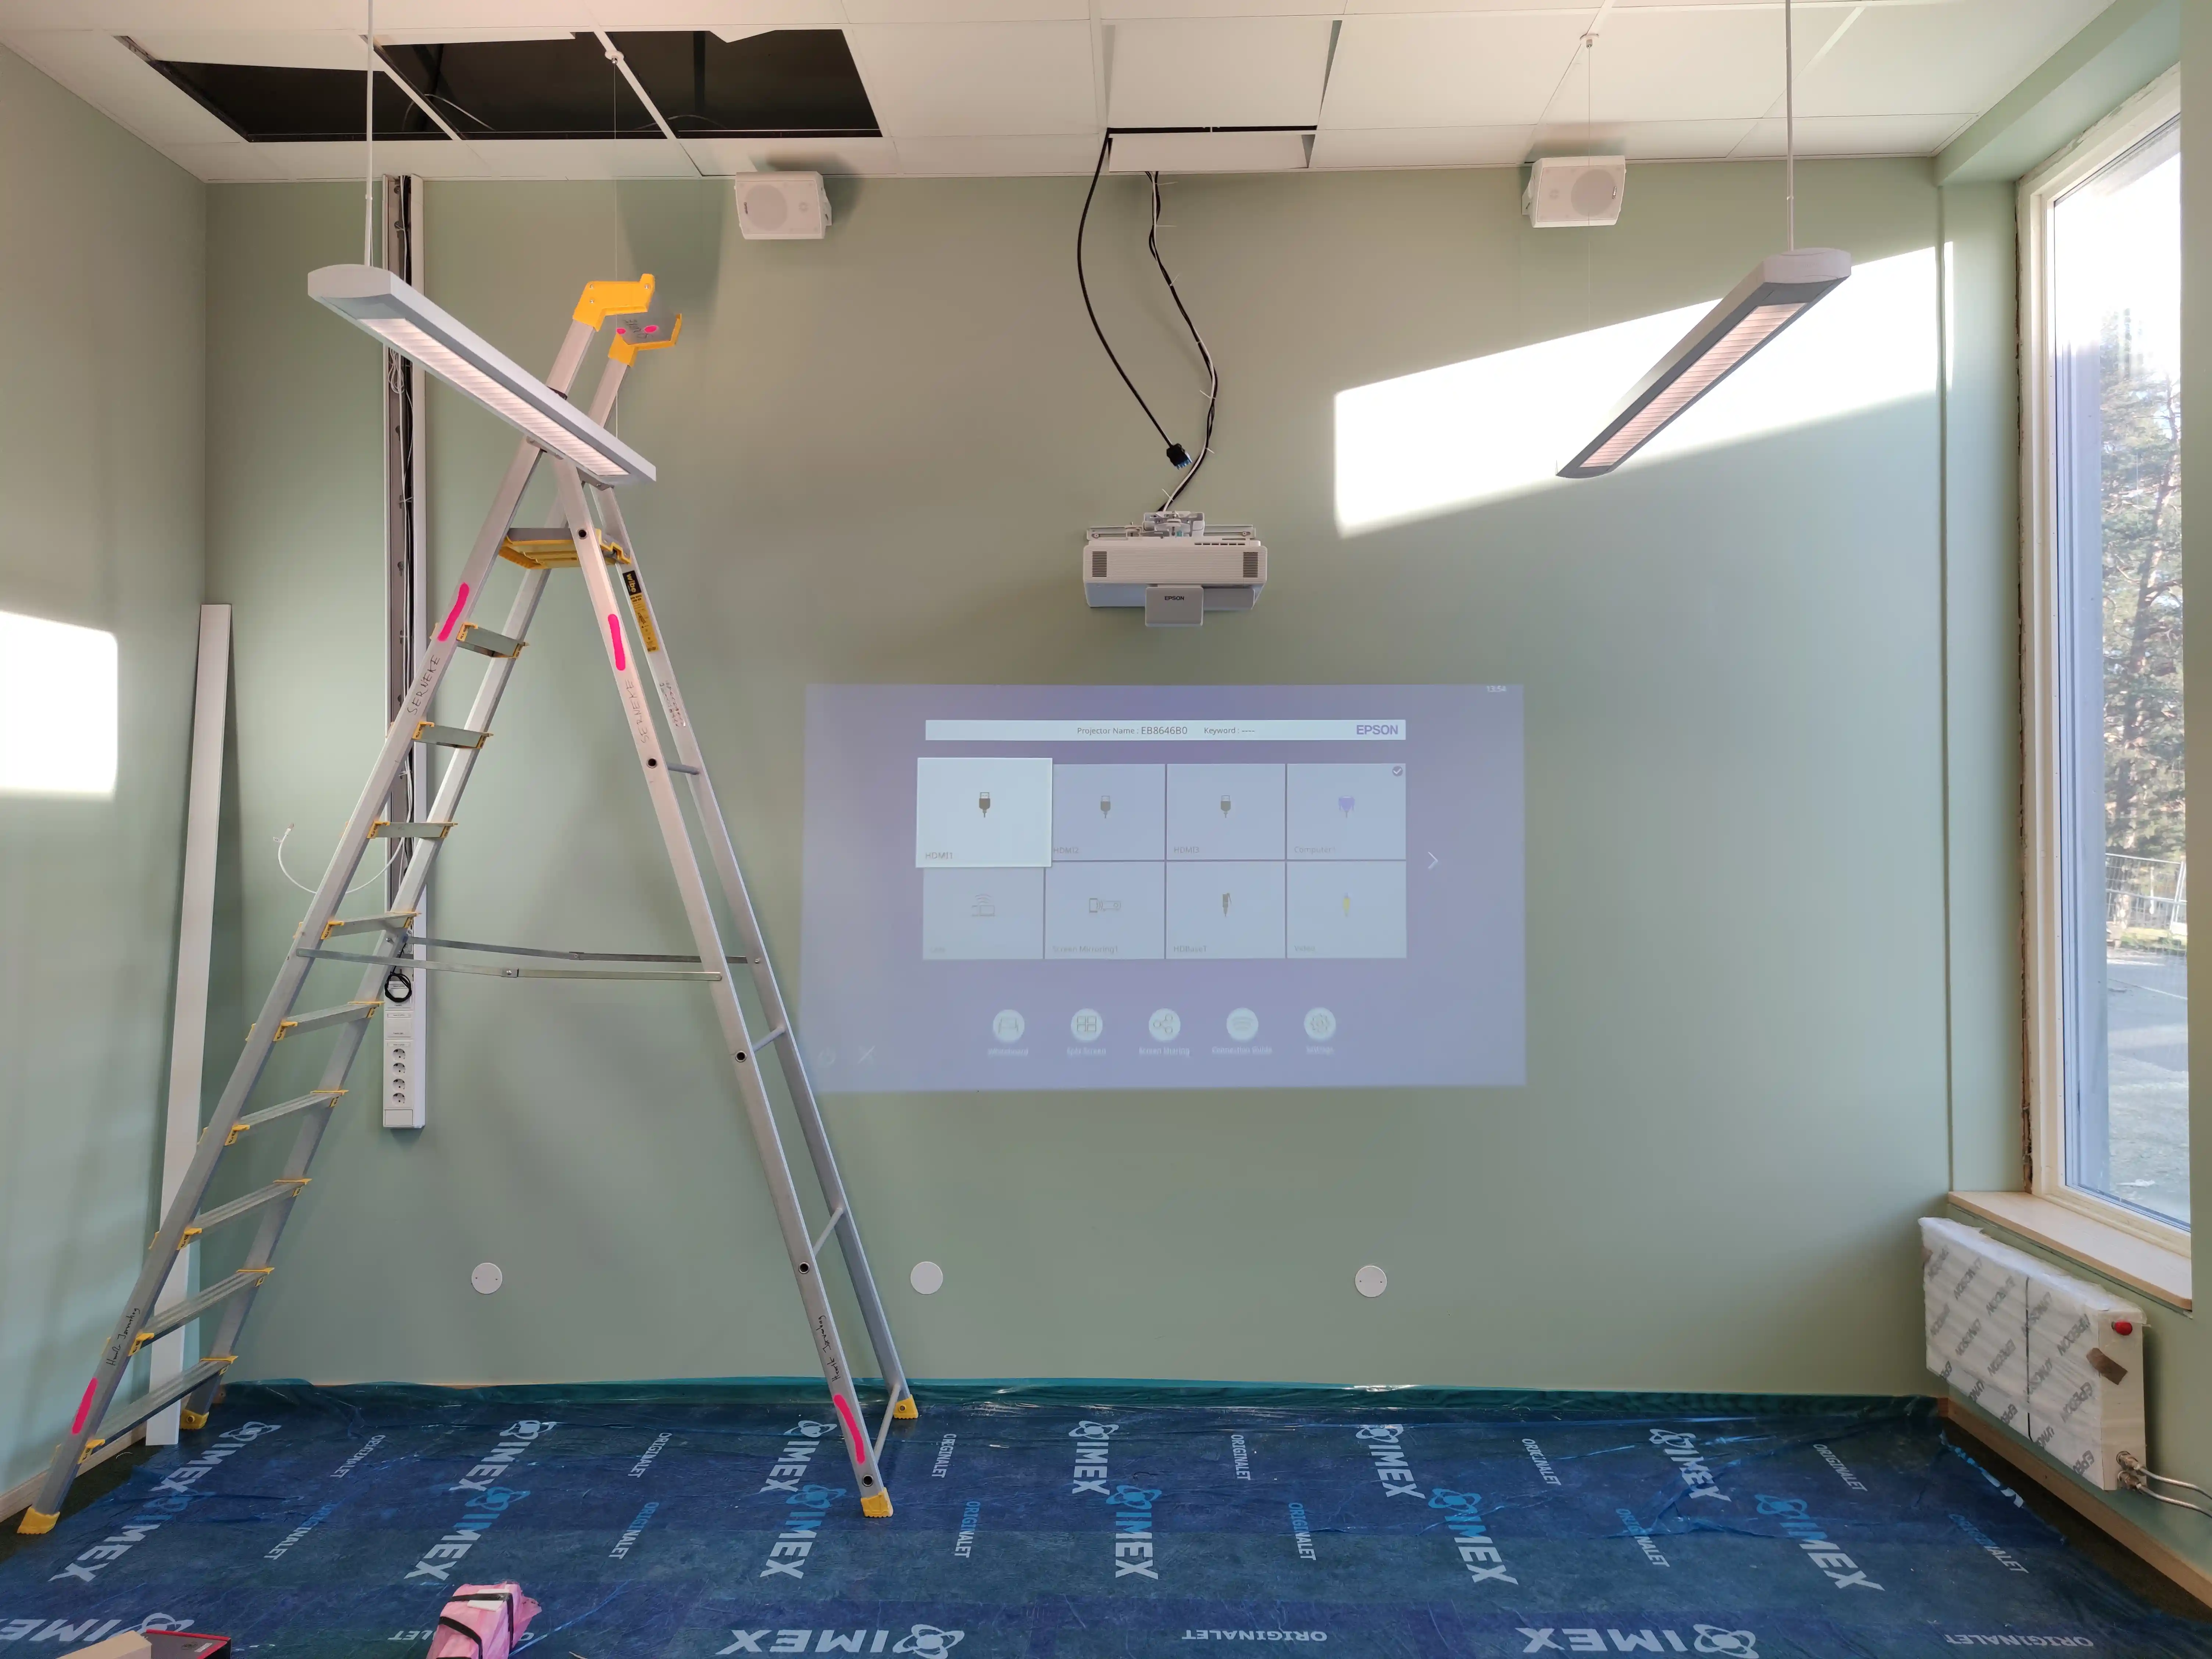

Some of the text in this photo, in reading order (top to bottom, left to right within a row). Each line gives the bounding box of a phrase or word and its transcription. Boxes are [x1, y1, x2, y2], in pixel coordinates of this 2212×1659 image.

[1077, 727, 1111, 736] Projector
[1141, 726, 1188, 735] EB8646B0
[1204, 727, 1236, 735] Keyword
[1356, 724, 1399, 735] EPSON
[925, 852, 953, 860] HDMI1
[150, 1444, 247, 1493] IMEX
[449, 1442, 531, 1491] IMEX
[628, 1432, 672, 1478] ORIGINALET
[760, 1441, 820, 1492] IMEX
[932, 1433, 957, 1478] ORIGINALET
[1072, 1442, 1110, 1495] IMEX
[1231, 1434, 1251, 1480] ORIGINALET
[1368, 1445, 1426, 1499] IMEX
[1813, 1444, 1868, 1491] ORIGINALET
[48, 1515, 172, 1582] IMEX
[404, 1513, 500, 1580] IMEX
[609, 1502, 660, 1559] ORIGINALET
[760, 1511, 826, 1579] IMEX
[954, 1501, 981, 1558] ORIGINALET
[1116, 1512, 1159, 1580] IMEX
[1288, 1502, 1316, 1560] ORIGINALET
[1444, 1515, 1519, 1585] IMEX
[1779, 1522, 1885, 1591] IMEX
[0, 1619, 122, 1641] IME
[715, 1630, 889, 1655] IMEX
[1182, 1629, 1328, 1642] ORIGINALET
[1515, 1628, 1688, 1653] IMEX
[1946, 1634, 2094, 1646] ORIGINALET
